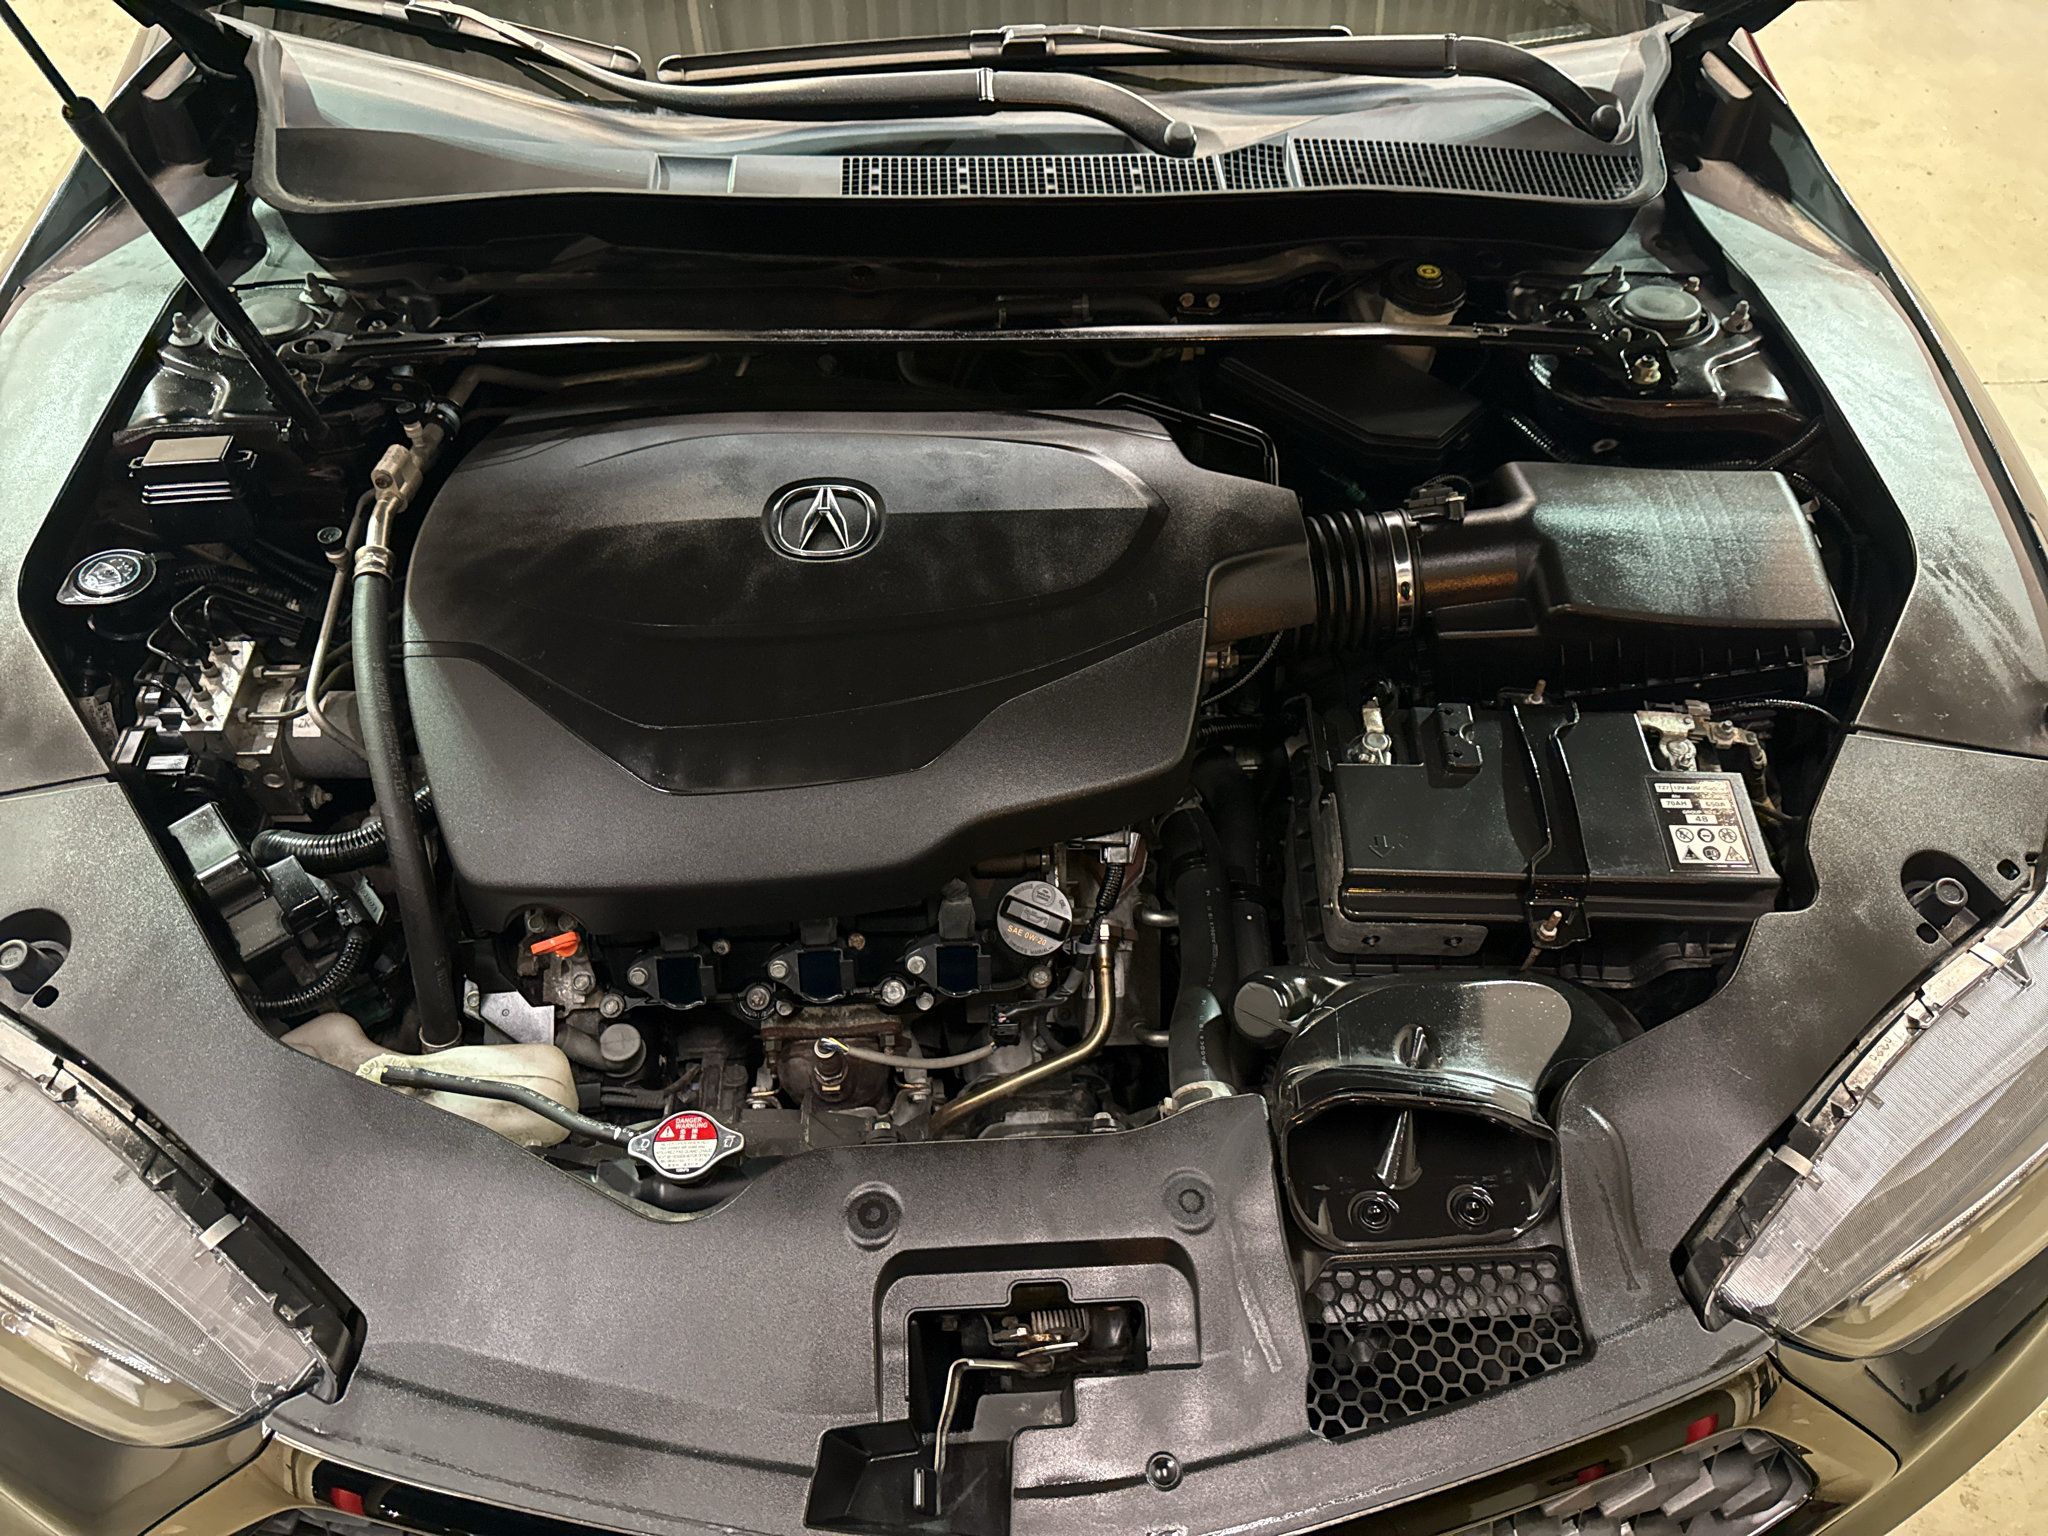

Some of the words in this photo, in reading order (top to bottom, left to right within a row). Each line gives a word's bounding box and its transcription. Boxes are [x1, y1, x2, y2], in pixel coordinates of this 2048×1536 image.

[1695, 815, 1709, 823] 48
[1007, 925, 1023, 936] SAE
[1024, 932, 1047, 946] 0W-20
[676, 1116, 702, 1124] DANGER
[676, 1121, 708, 1130] WARNUNG
